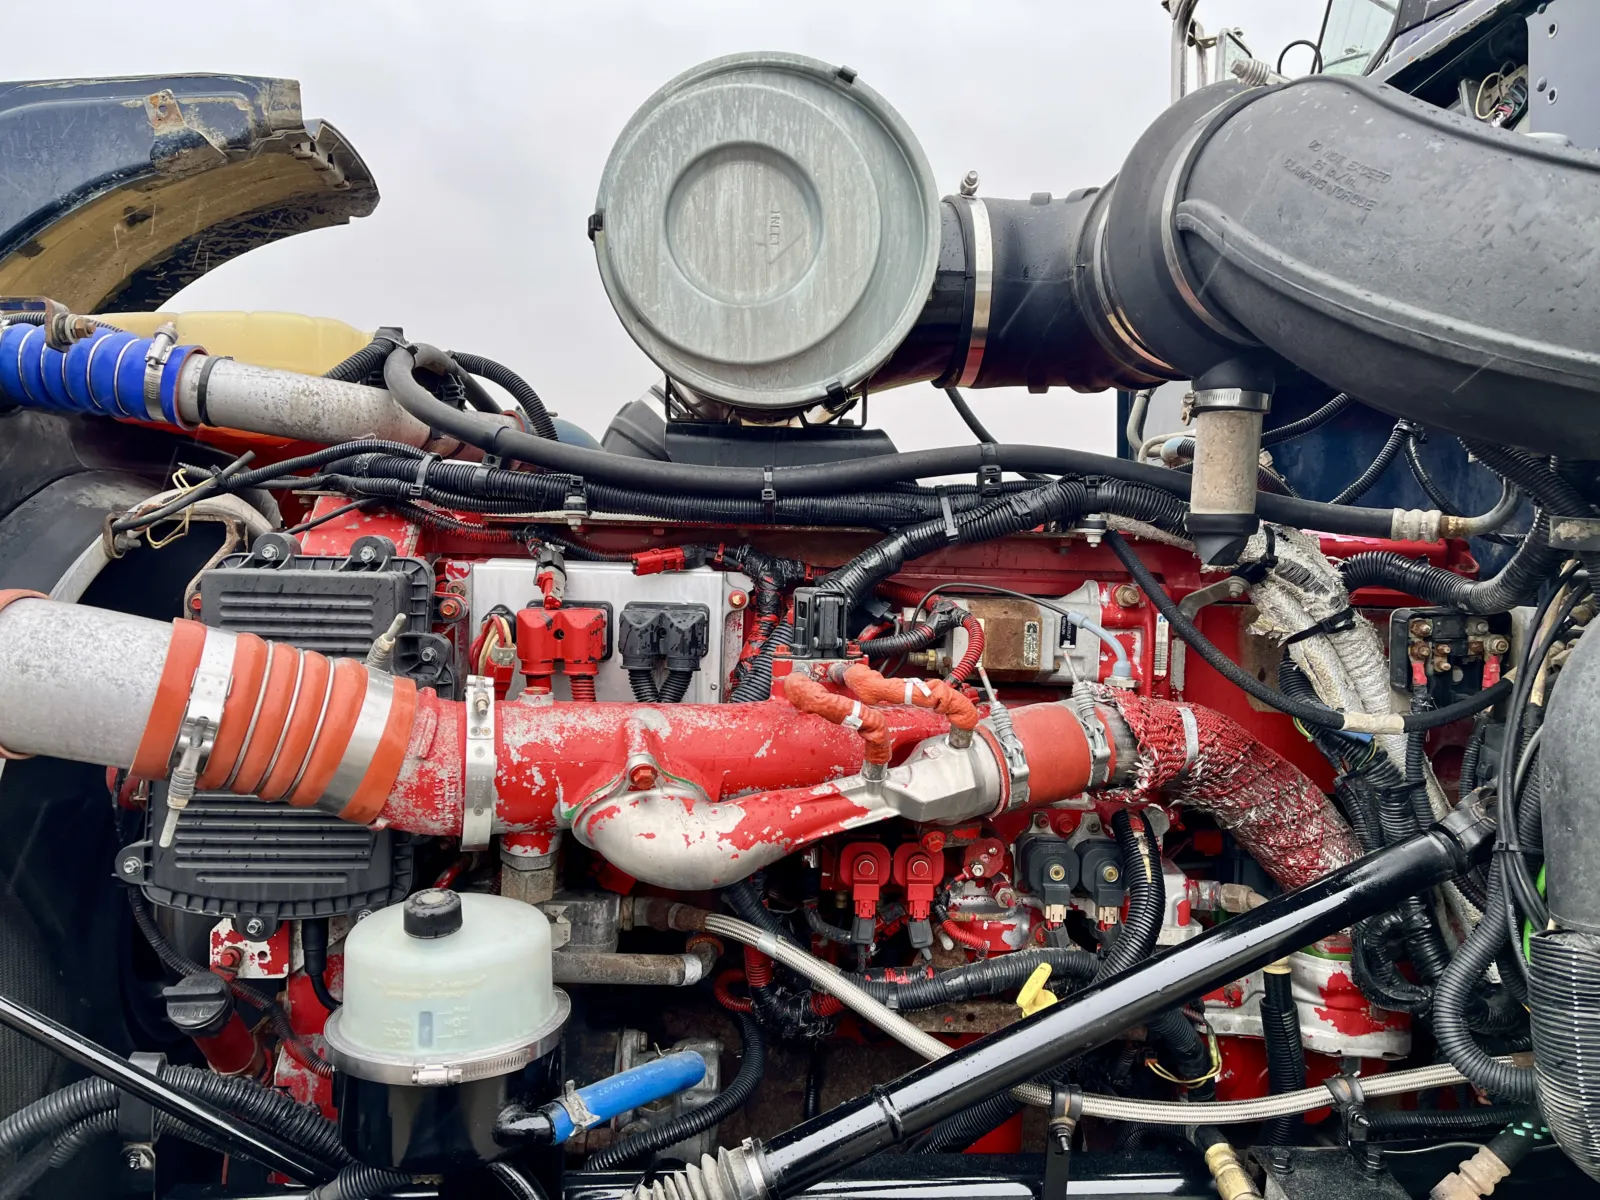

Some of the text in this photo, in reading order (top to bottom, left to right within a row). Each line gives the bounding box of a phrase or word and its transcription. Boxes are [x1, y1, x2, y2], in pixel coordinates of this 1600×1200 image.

[1308, 139, 1392, 184] DO NOT EXCEED
[1284, 158, 1378, 212] CLAMPING TORQUE
[383, 1027, 412, 1038] COLD
